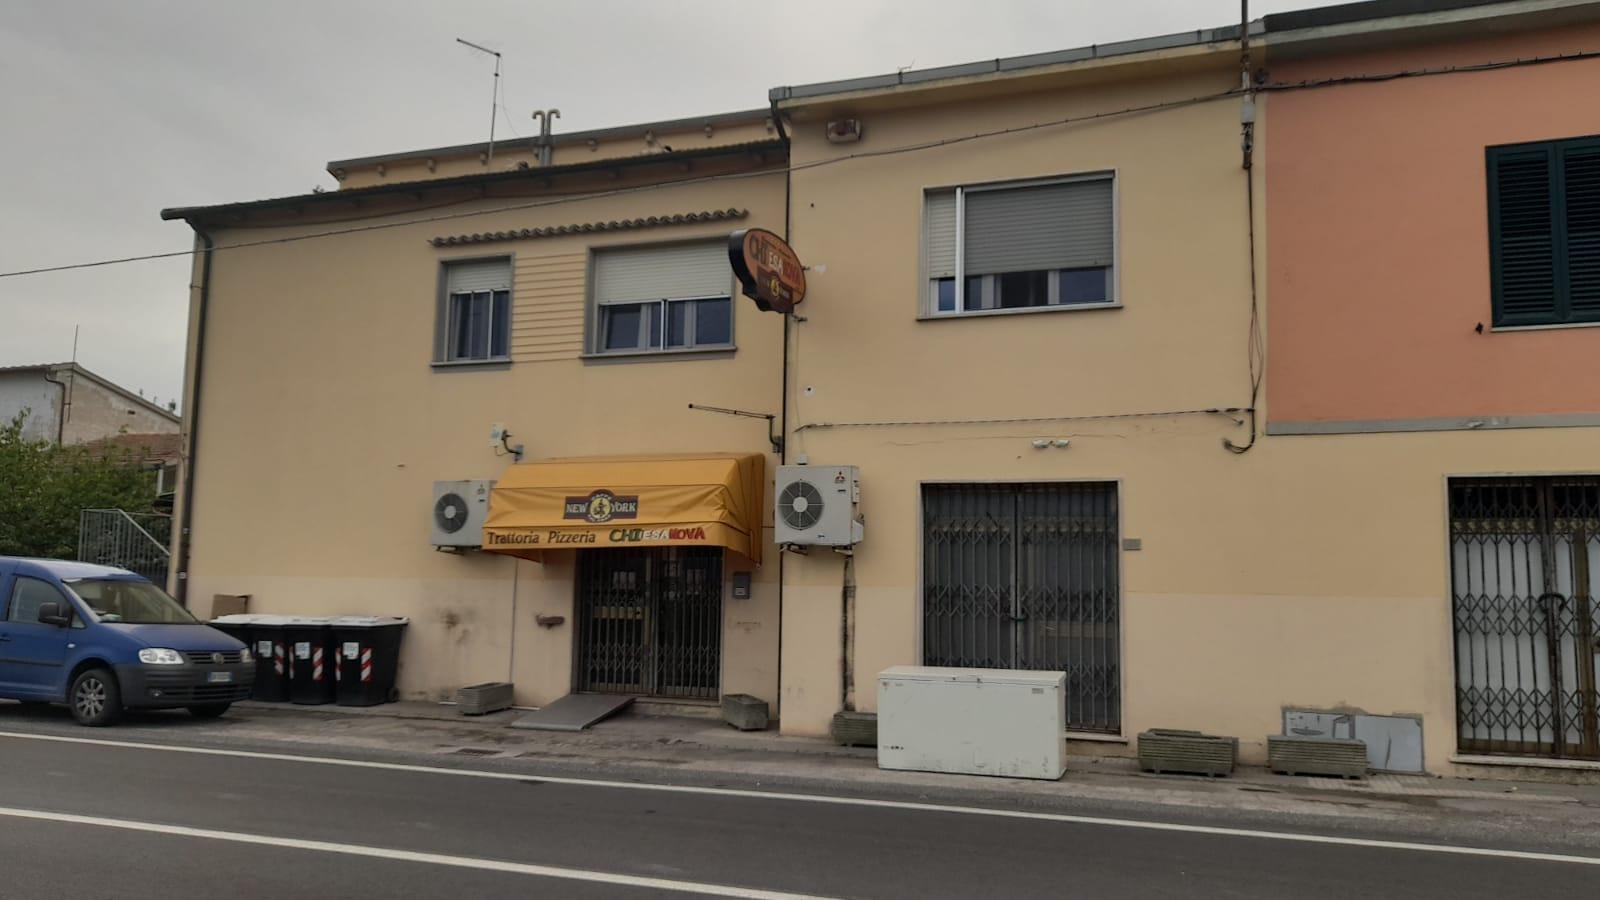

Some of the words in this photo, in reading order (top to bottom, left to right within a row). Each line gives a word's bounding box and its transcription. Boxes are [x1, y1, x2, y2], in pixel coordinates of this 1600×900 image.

[566, 502, 589, 513] NEW
[610, 501, 637, 513] YORK
[488, 531, 540, 544] Trattoria
[547, 530, 596, 544] Pizzeria
